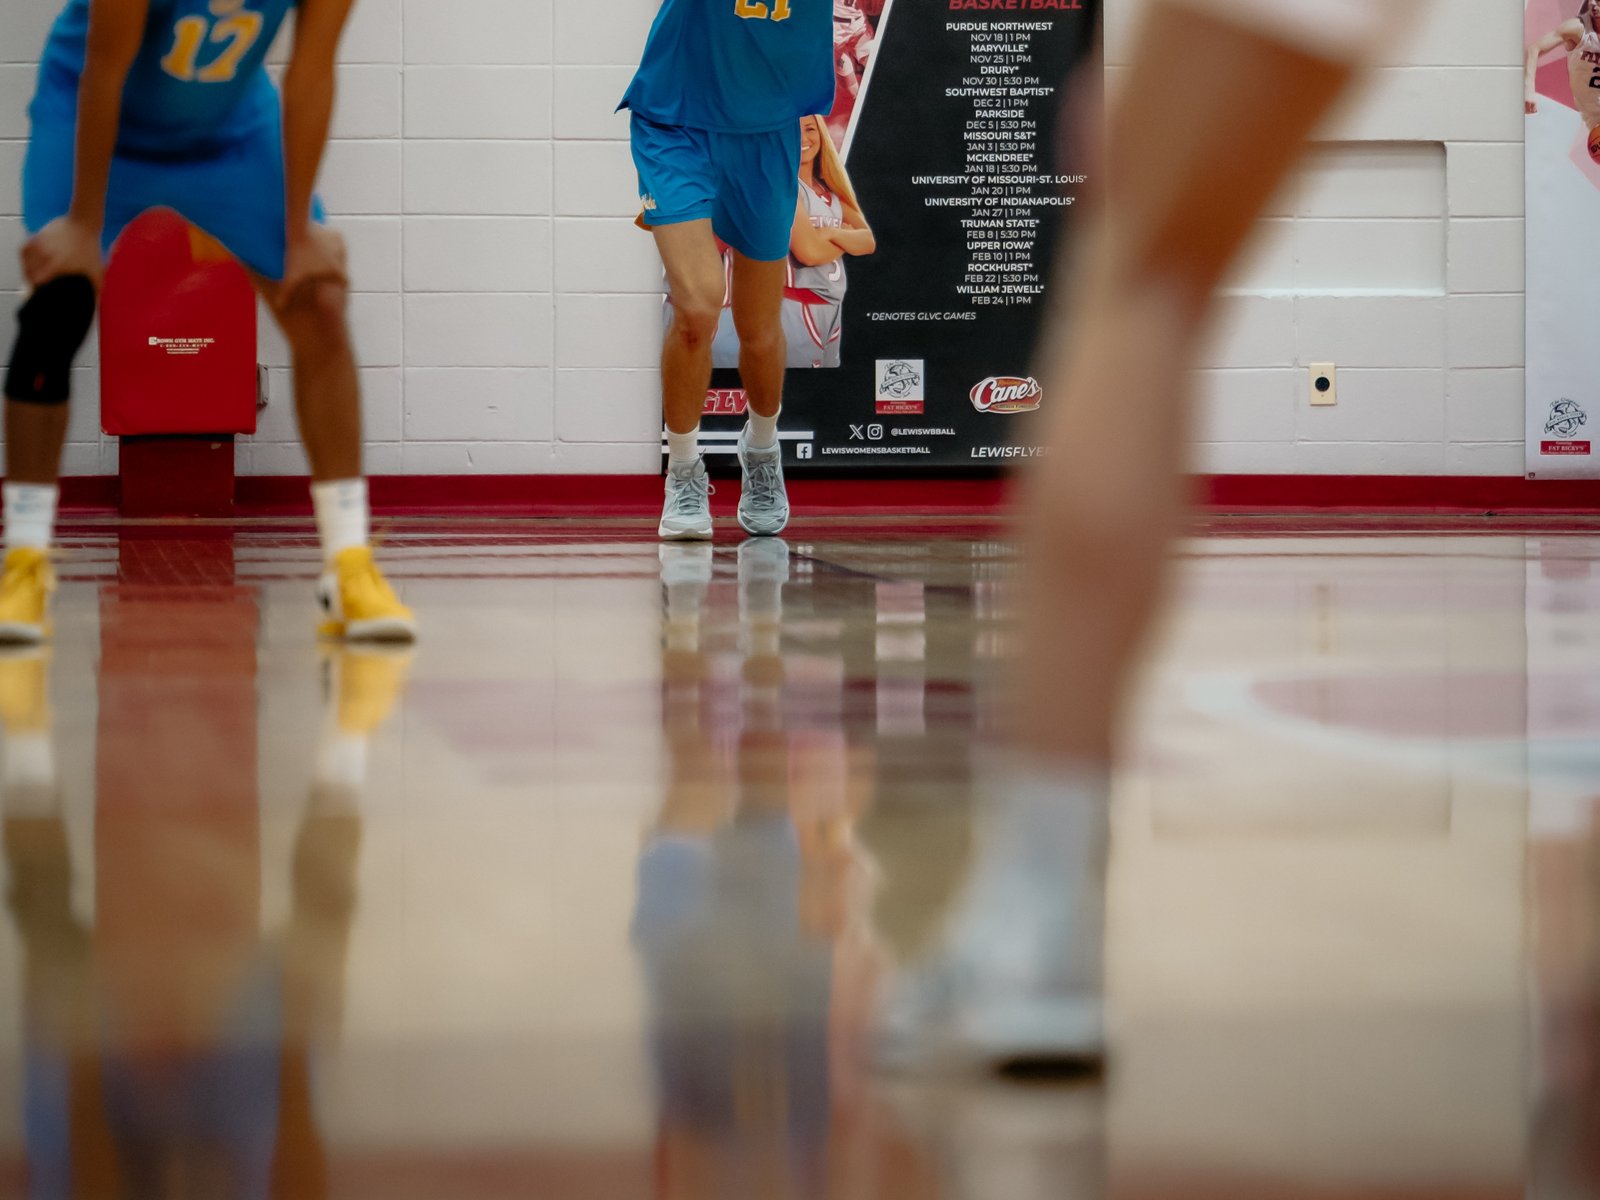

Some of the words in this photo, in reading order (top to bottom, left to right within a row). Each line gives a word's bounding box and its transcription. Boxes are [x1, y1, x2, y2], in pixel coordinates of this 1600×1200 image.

[946, 22, 988, 31] PURDUE
[990, 22, 1053, 31] NORTHWEST
[970, 33, 992, 42] NOV
[993, 33, 1004, 42] 18
[1009, 33, 1014, 41] 1
[1015, 33, 1031, 41] PM
[161, 14, 263, 82] 17
[970, 55, 992, 64] NOV
[993, 54, 1004, 64] 25
[1010, 54, 1014, 63] 1
[1016, 54, 1032, 63] PM
[962, 77, 984, 85] NOV
[985, 76, 998, 85] 30
[1003, 76, 1023, 85] 5:30
[1024, 76, 1039, 85] PM
[945, 87, 1008, 97] SOUTHWEST
[973, 98, 994, 108] DEC
[995, 98, 1001, 107] 2
[1007, 98, 1011, 107] 1
[1013, 98, 1029, 107] PM
[975, 109, 1025, 118] PARKSIDE
[966, 120, 986, 129] DEC
[988, 120, 994, 129] 5
[1000, 120, 1019, 129] 5:30
[1021, 120, 1036, 129] PM
[963, 131, 1012, 140] MISSOURI
[966, 142, 985, 151] JAN
[987, 142, 993, 151] 3
[999, 142, 1019, 151] 5:30
[1020, 142, 1035, 151] PM
[964, 164, 984, 173] JAN
[985, 164, 995, 173] 18
[1001, 164, 1020, 173] 5:30
[1022, 164, 1037, 173] PM
[911, 175, 970, 185] UNIVERSITY
[971, 175, 986, 184] OF
[987, 175, 1053, 184] MISSOURI-ST.
[971, 186, 990, 195] JAN
[991, 186, 1004, 195] 20
[1010, 186, 1014, 195] 1
[1015, 186, 1031, 194] PM
[924, 197, 983, 206] UNIVERSITY
[984, 197, 999, 206] OF
[971, 208, 990, 217] JAN
[992, 208, 1003, 217] 27
[1009, 208, 1014, 217] 1
[1015, 208, 1031, 216] PM
[960, 219, 1004, 228] TRUMAN
[966, 230, 986, 239] FEB
[987, 230, 994, 239] 8
[1000, 230, 1019, 239] 5:30
[1021, 230, 1036, 238] PM
[967, 241, 1001, 250] UPPER
[972, 252, 992, 261] FEB
[993, 252, 1003, 261] 10
[1009, 252, 1013, 260] 1
[1015, 252, 1031, 260] PM
[964, 274, 984, 283] FEB
[985, 274, 996, 283] 22
[1002, 274, 1022, 283] 5:30
[1023, 274, 1038, 282] PM
[956, 285, 1000, 294] WILLIAM
[971, 296, 991, 305] FEB
[992, 296, 1004, 305] 24
[1010, 296, 1014, 304] 1
[1016, 296, 1031, 304] PM
[872, 312, 916, 321] DENOTES
[917, 312, 942, 321] GLVC
[943, 312, 977, 320] GAMES
[702, 389, 751, 414] GLV
[890, 428, 956, 436] @LEWISWBBALL
[821, 447, 931, 455] LEWISWOMENSBASKETBALL
